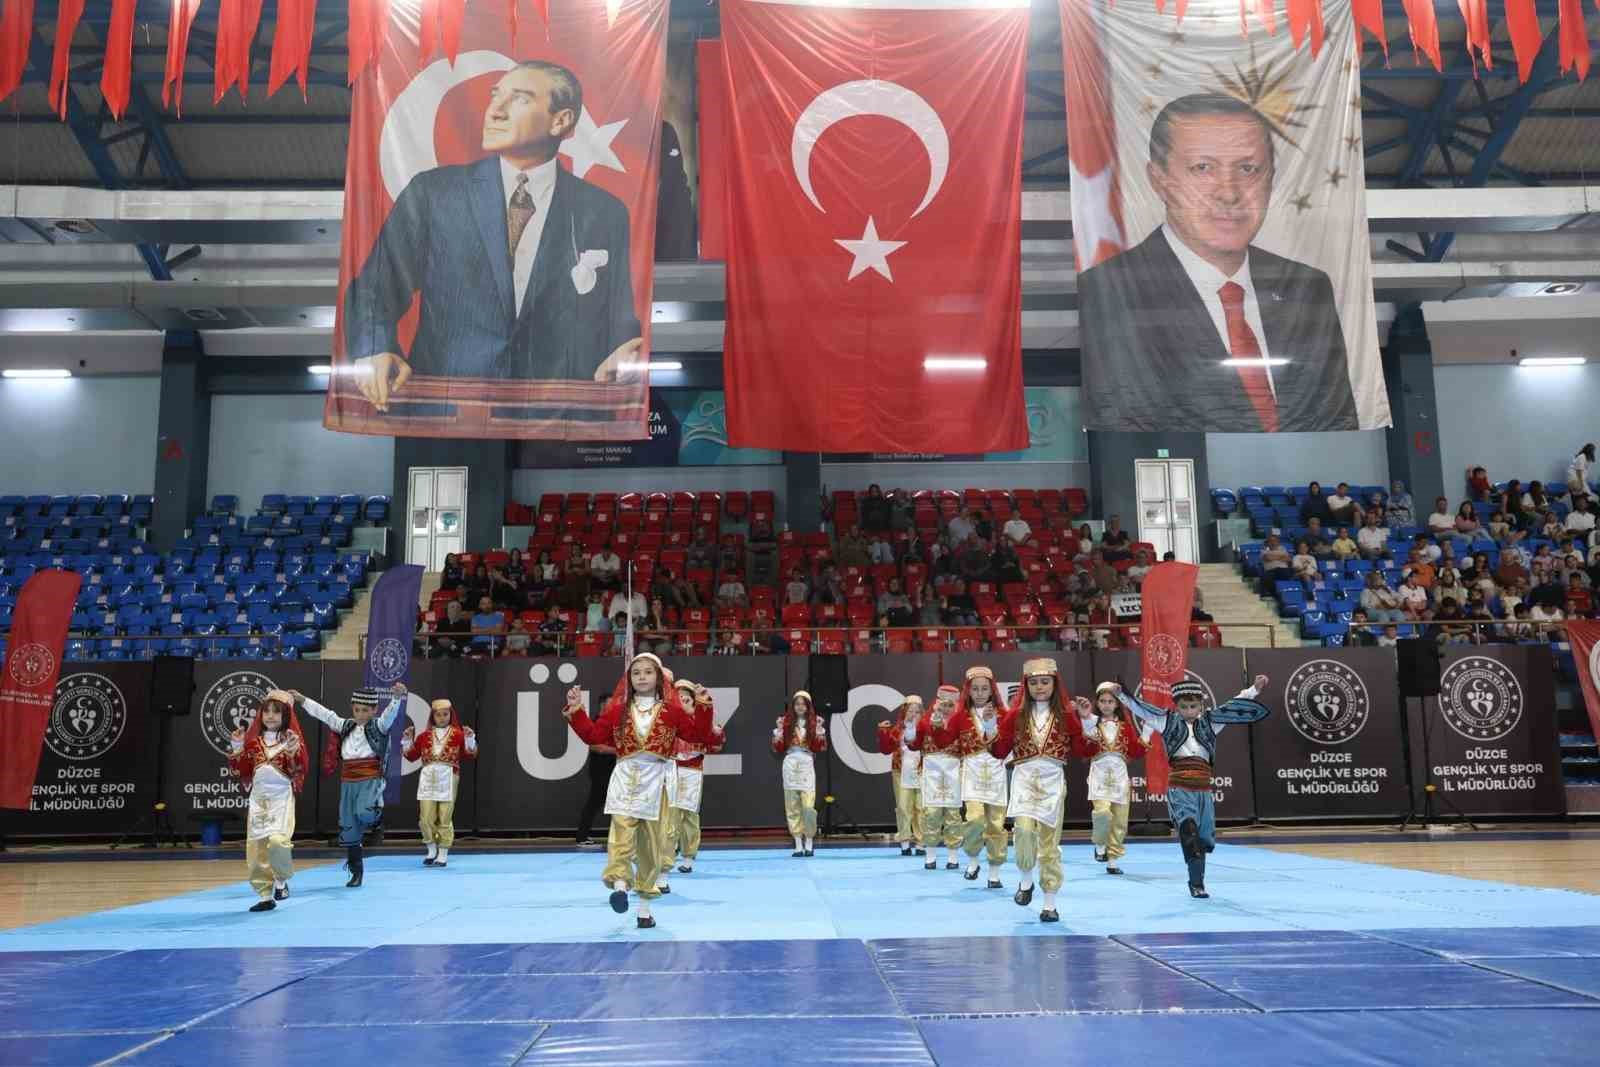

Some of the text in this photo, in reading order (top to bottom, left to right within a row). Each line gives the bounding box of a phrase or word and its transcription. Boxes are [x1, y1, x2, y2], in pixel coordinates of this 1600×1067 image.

[1310, 750, 1352, 762] DÜZCE
[1465, 747, 1508, 759] DÜZCE
[57, 765, 101, 778] DÜZCE
[1277, 765, 1387, 780] GENÇLİK VE SPOR
[1433, 762, 1544, 777] GENÇLİK VE SPOR
[32, 782, 136, 797] ENÇLİK VE SPOR
[184, 780, 240, 795] GENÇLİK
[1287, 780, 1380, 794] İL MÜDÜRLÜĞÜ
[1443, 776, 1536, 791] İL MÜDÜRLÜĞÜ
[43, 796, 125, 810] MÜDÜRLÜĞÜ
[192, 796, 251, 809] İL MÜDÜR
